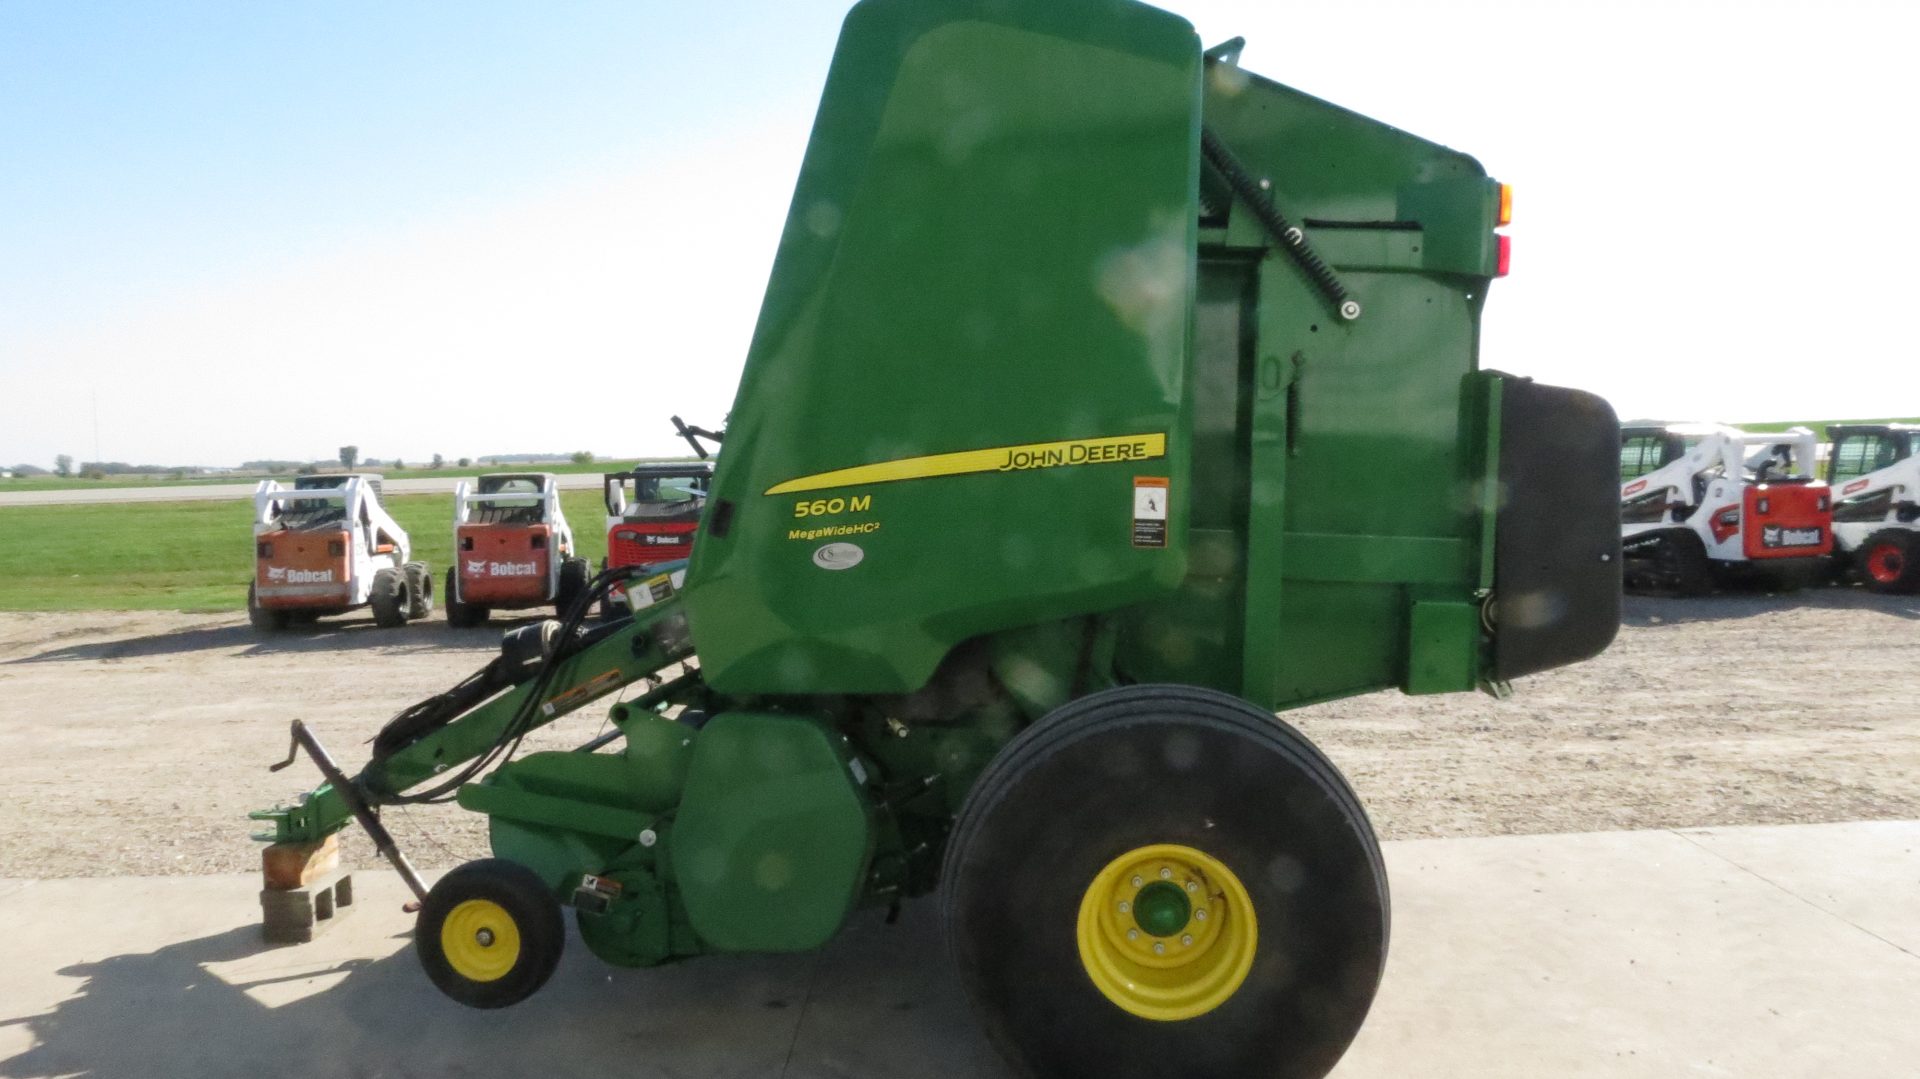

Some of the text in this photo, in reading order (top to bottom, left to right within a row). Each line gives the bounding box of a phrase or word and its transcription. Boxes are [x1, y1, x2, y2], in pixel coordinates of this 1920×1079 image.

[1000, 442, 1146, 469] JOHN DEERE
[794, 495, 872, 518] 560 M
[656, 535, 679, 544] Bobcat
[1782, 529, 1820, 545] Bobcat
[287, 569, 333, 583] Bobcat
[490, 561, 537, 576] Bobcat
